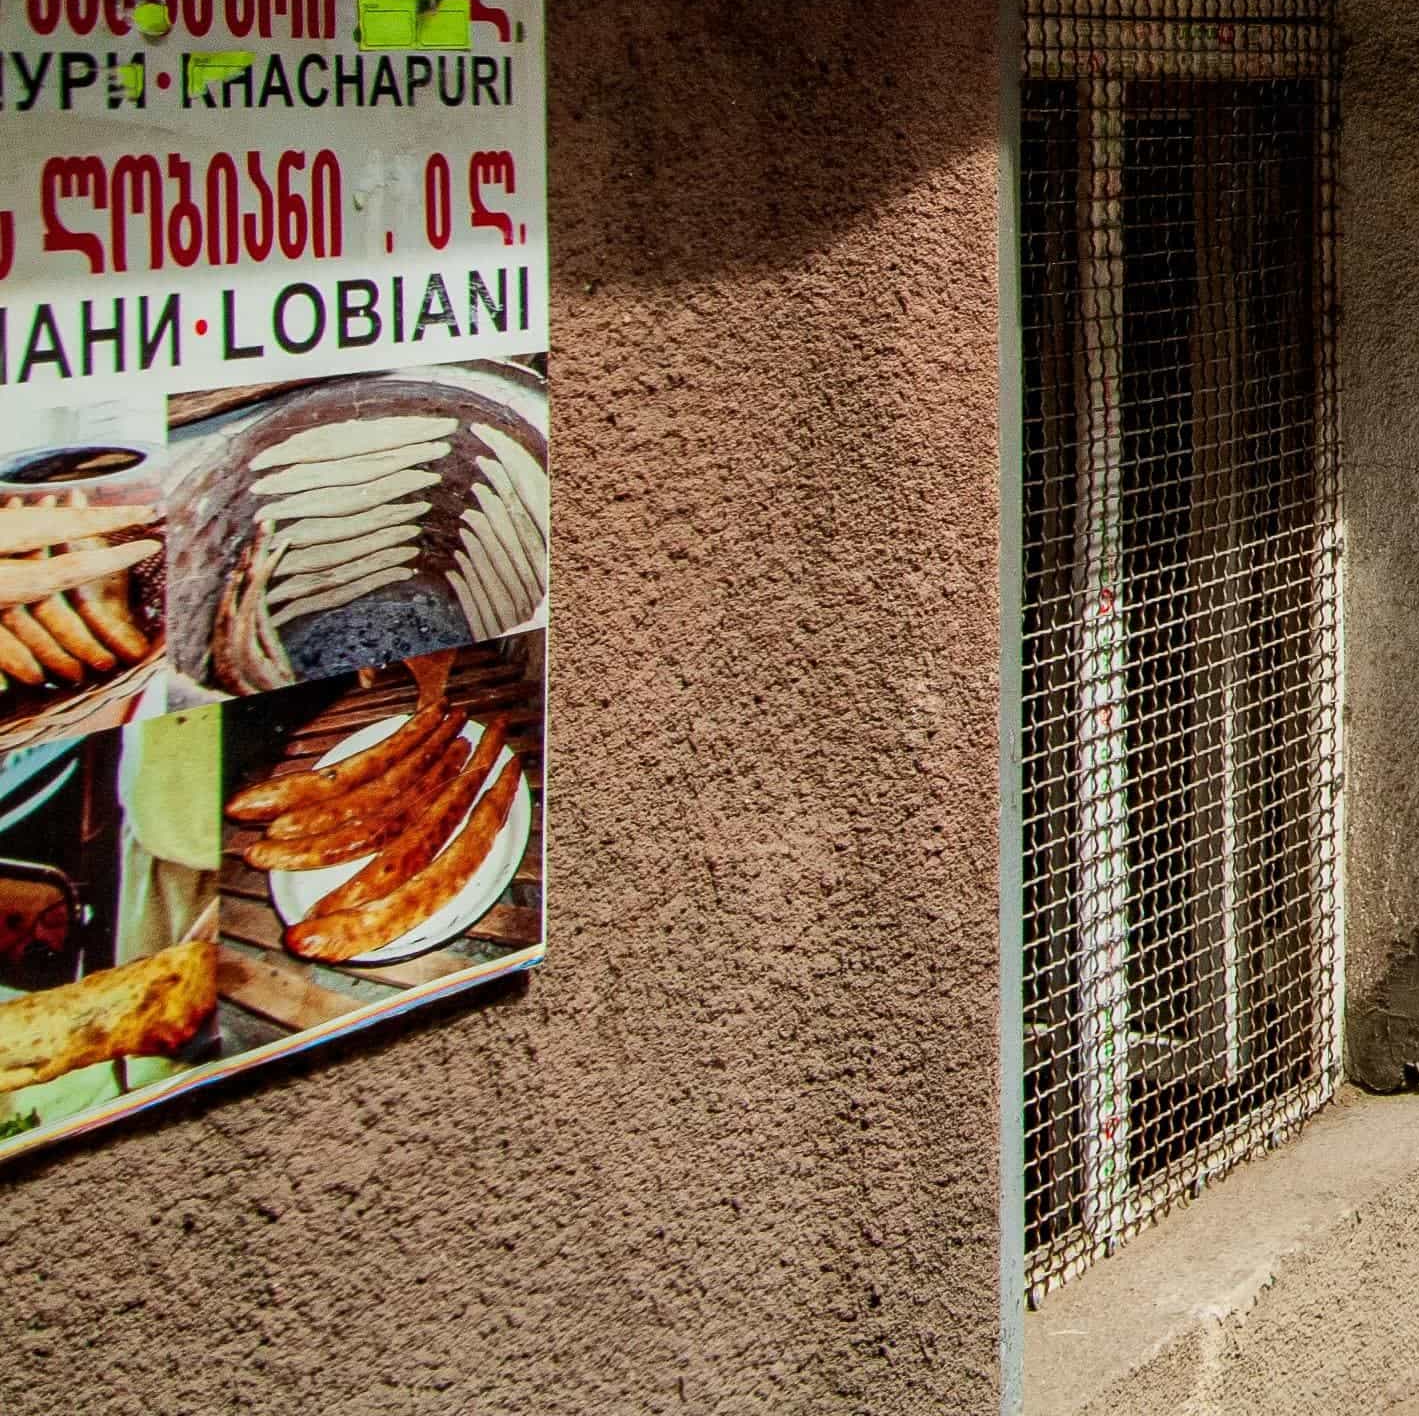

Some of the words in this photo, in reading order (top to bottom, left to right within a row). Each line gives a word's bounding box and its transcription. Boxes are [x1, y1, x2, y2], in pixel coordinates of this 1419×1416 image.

[0, 51, 146, 111] УРИ
[42, 148, 342, 274] ლობიანი
[222, 265, 529, 362] LOBIANI
